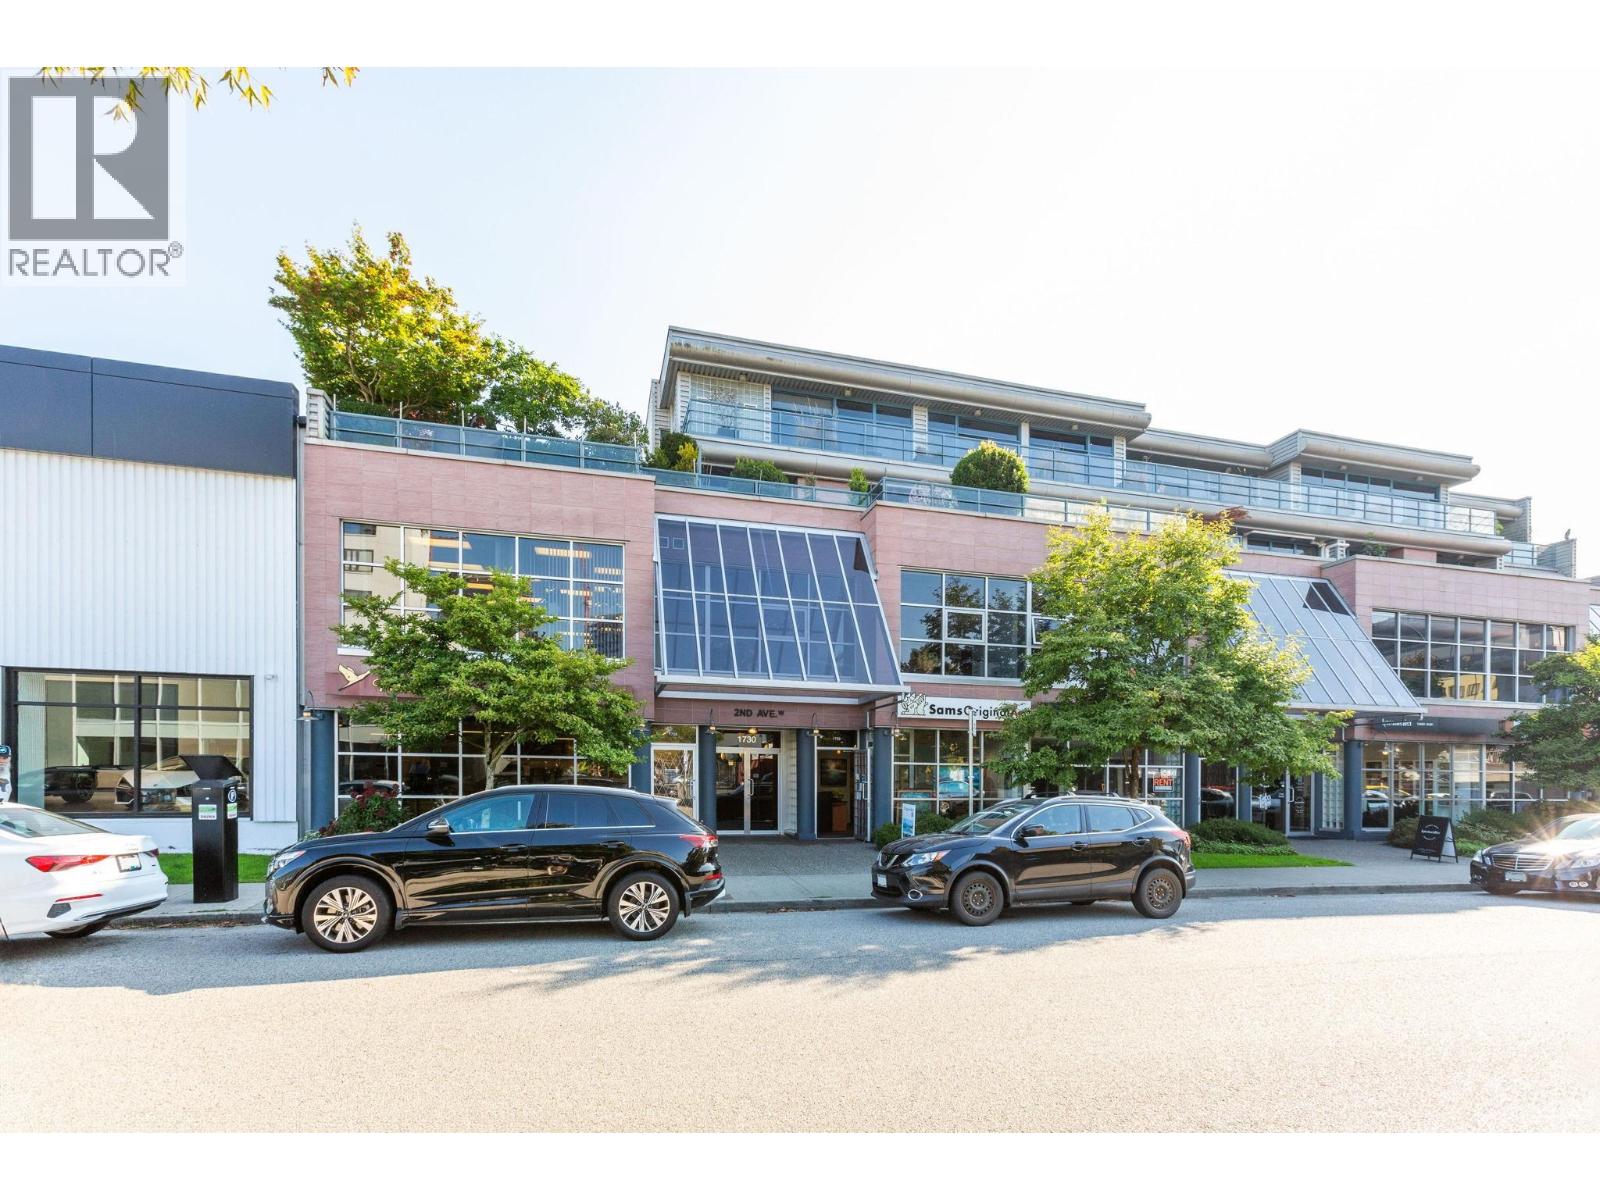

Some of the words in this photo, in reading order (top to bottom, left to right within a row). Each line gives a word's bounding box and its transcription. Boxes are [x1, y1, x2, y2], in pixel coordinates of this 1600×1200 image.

[734, 708, 753, 717] 2ND
[737, 735, 756, 743] 1730
[1154, 778, 1172, 786] RENT
